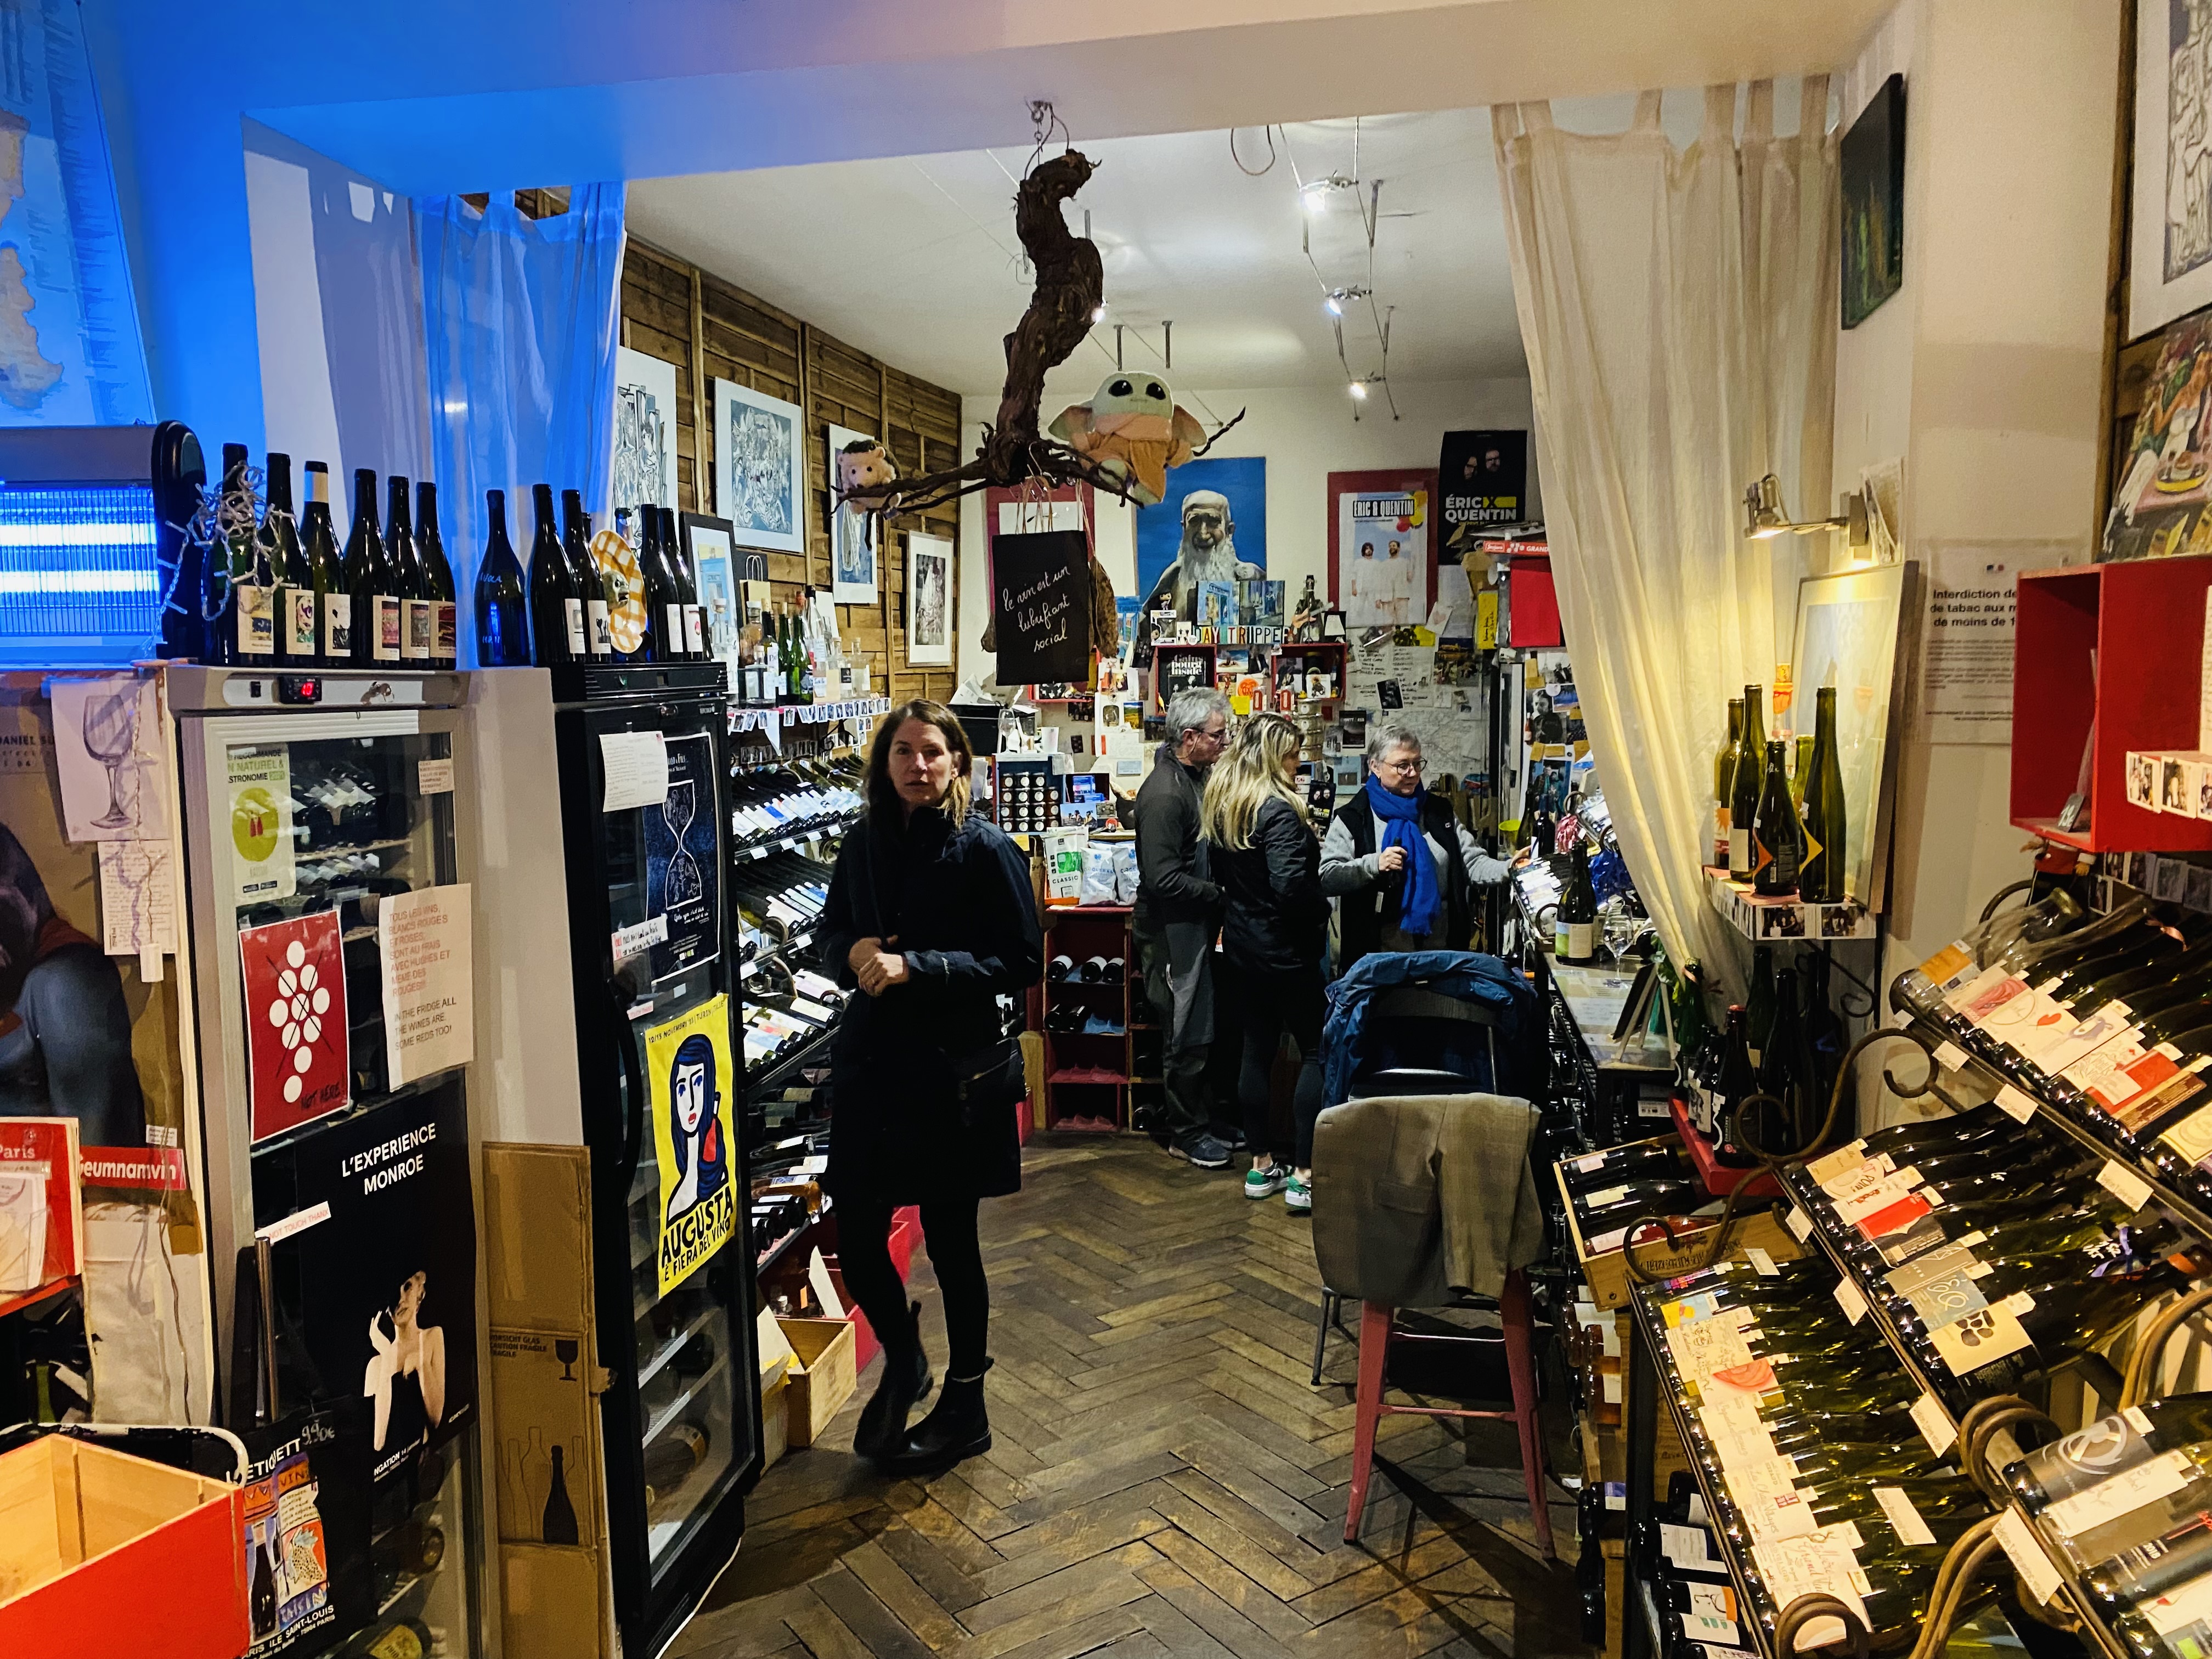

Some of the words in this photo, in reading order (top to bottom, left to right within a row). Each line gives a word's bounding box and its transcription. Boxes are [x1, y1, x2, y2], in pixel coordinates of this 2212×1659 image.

[1380, 500, 1414, 517] QUENTIN
[1446, 494, 1482, 509] ÉRIC
[1445, 509, 1516, 523] QUENTIN
[1003, 588, 1014, 611] le
[1017, 583, 1036, 603] vin
[1037, 572, 1051, 591] est
[1053, 566, 1070, 582] un
[1933, 589, 2000, 599] Interdiction
[1018, 593, 1070, 631] lubrifiant
[1930, 604, 1944, 613] de
[1948, 604, 1980, 613] tabac
[1934, 617, 1947, 626] de
[1952, 617, 1987, 626] moins
[1991, 617, 2006, 626] de
[1034, 617, 1068, 652] social
[236, 759, 278, 771] NATUREL
[228, 772, 268, 783] STRONOMIE
[1052, 876, 1079, 884] CLASSIC
[389, 911, 407, 922] TOUS
[389, 921, 416, 935] BLANCS
[417, 915, 448, 928] ROUGES
[390, 947, 408, 960] SONT
[410, 944, 420, 954] AU
[421, 940, 441, 951] FRAIS
[391, 960, 409, 972] AVEC
[440, 950, 450, 959] ET
[394, 1012, 401, 1022] IN
[402, 1007, 415, 1019] THE
[416, 1000, 441, 1015] FRIDGE
[442, 996, 456, 1008] ALL
[697, 1009, 712, 1021] TURIN
[394, 1025, 407, 1036] THE
[408, 1017, 430, 1031] WINES
[394, 1036, 415, 1051] SOME
[416, 1030, 434, 1042] REDS
[342, 1122, 436, 1177] L'EXPERIENCE
[364, 1154, 424, 1195] MONROE
[284, 1218, 307, 1232] TOUCH
[662, 1186, 733, 1269] AUGUSTA
[673, 1245, 697, 1276] FIERA
[699, 1233, 710, 1256] DEL
[712, 1216, 730, 1242] VINO
[2142, 1542, 2160, 1560] 2018
[269, 1634, 283, 1648] ILE
[285, 1604, 334, 1638] SAINT-LOUIS
